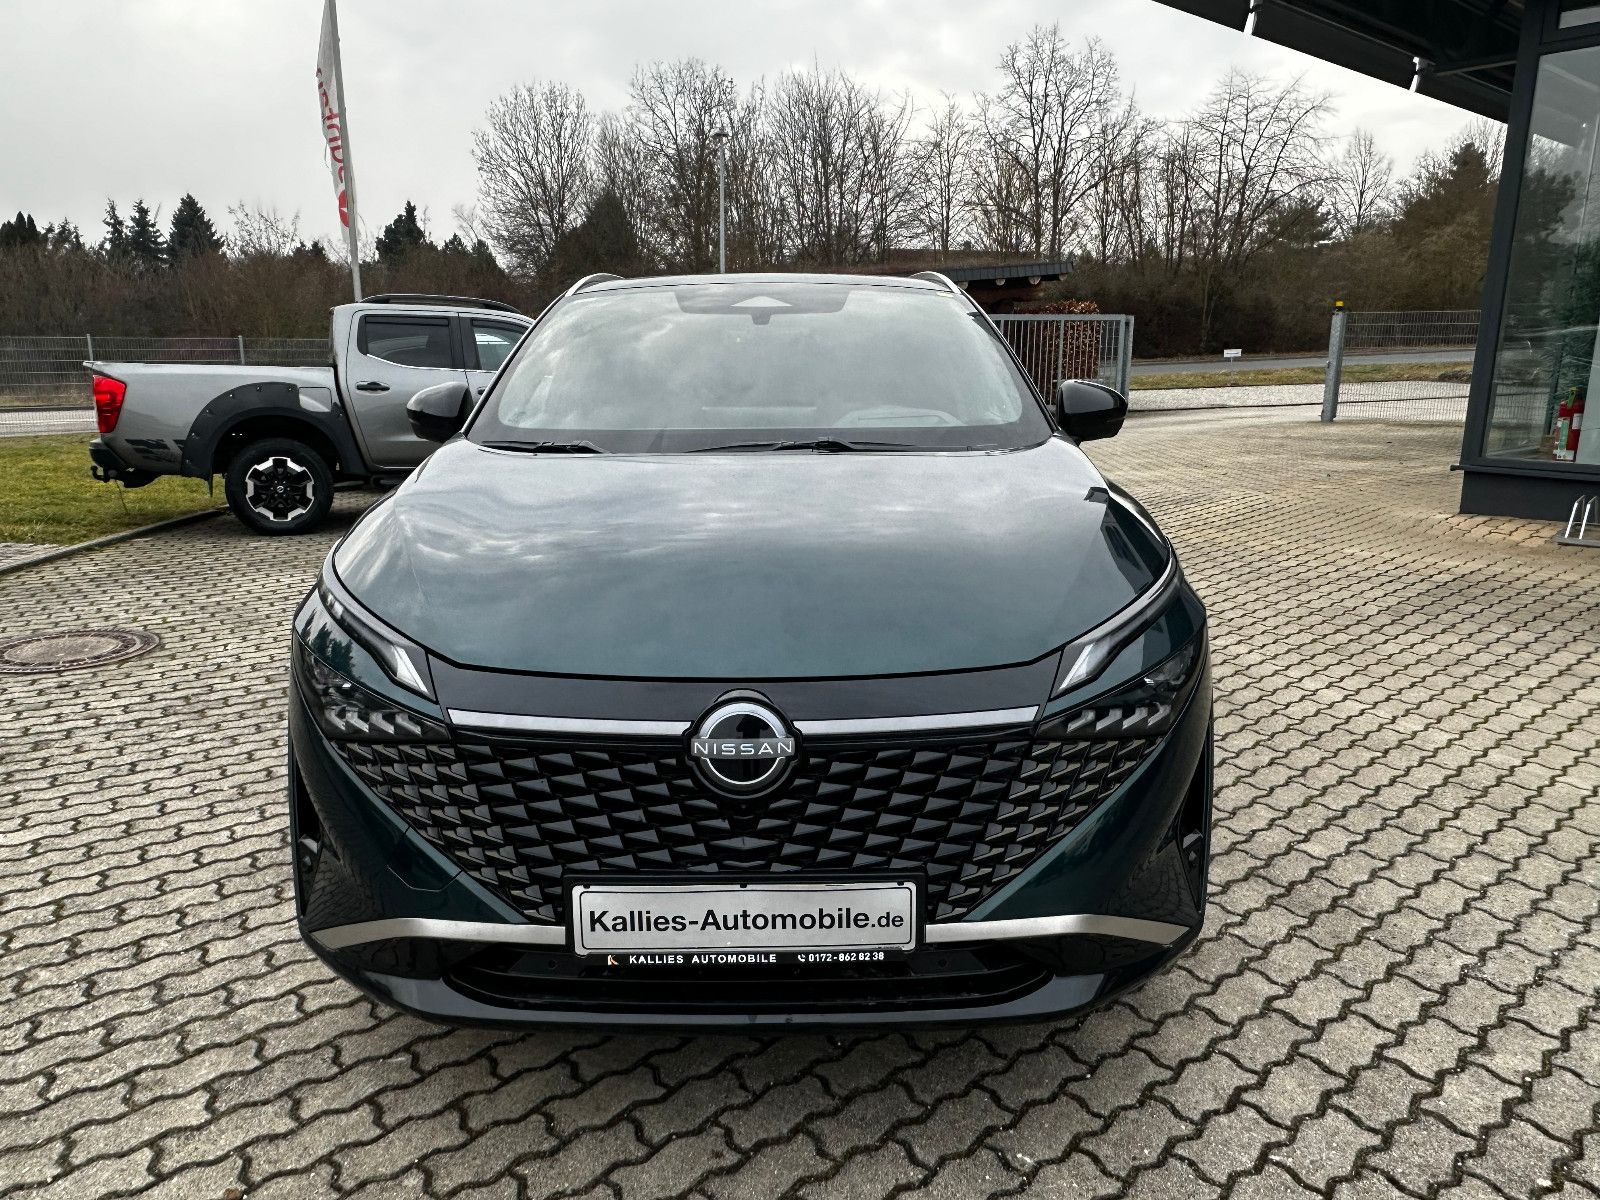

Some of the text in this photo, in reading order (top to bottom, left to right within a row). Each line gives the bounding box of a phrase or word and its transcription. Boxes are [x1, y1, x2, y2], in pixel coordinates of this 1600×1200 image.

[694, 740, 792, 755] NISSAN
[589, 907, 904, 932] Kallies-Automobile.de
[629, 954, 684, 965] KALLIES
[691, 953, 777, 964] AUTOMOBILE
